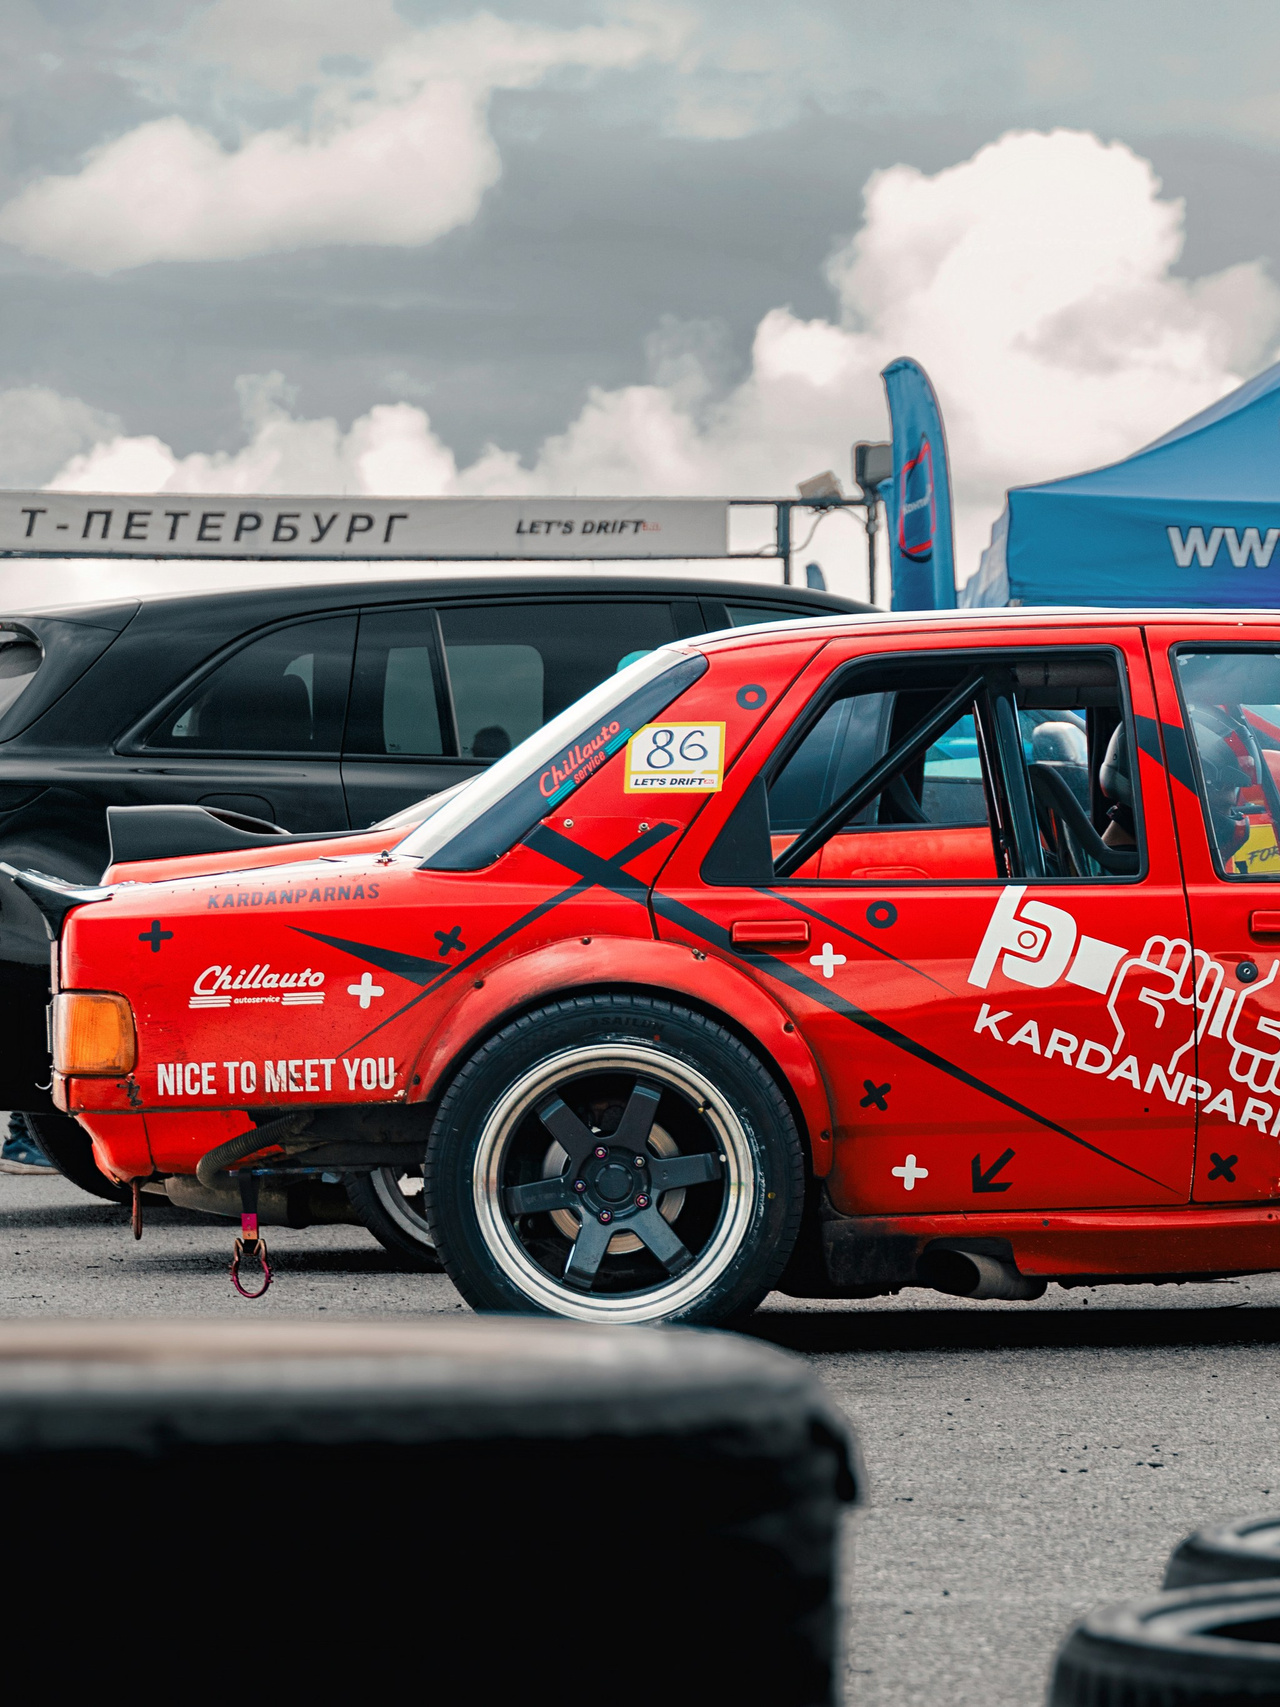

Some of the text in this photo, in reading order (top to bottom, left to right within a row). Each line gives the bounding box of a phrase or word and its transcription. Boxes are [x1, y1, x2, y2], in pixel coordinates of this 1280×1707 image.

[516, 519, 574, 535] LET'S
[581, 519, 645, 535] DRIFT
[539, 721, 620, 797] Chillauto
[646, 729, 708, 769] 86
[573, 751, 606, 784] service
[634, 778, 666, 786] LET'S
[669, 778, 705, 786] DRIFT
[207, 883, 380, 909] KARDANPARNAS
[193, 964, 325, 995] Chillauto
[233, 995, 281, 1004] autoservice
[157, 1057, 395, 1096] NICE TO MEET YOU
